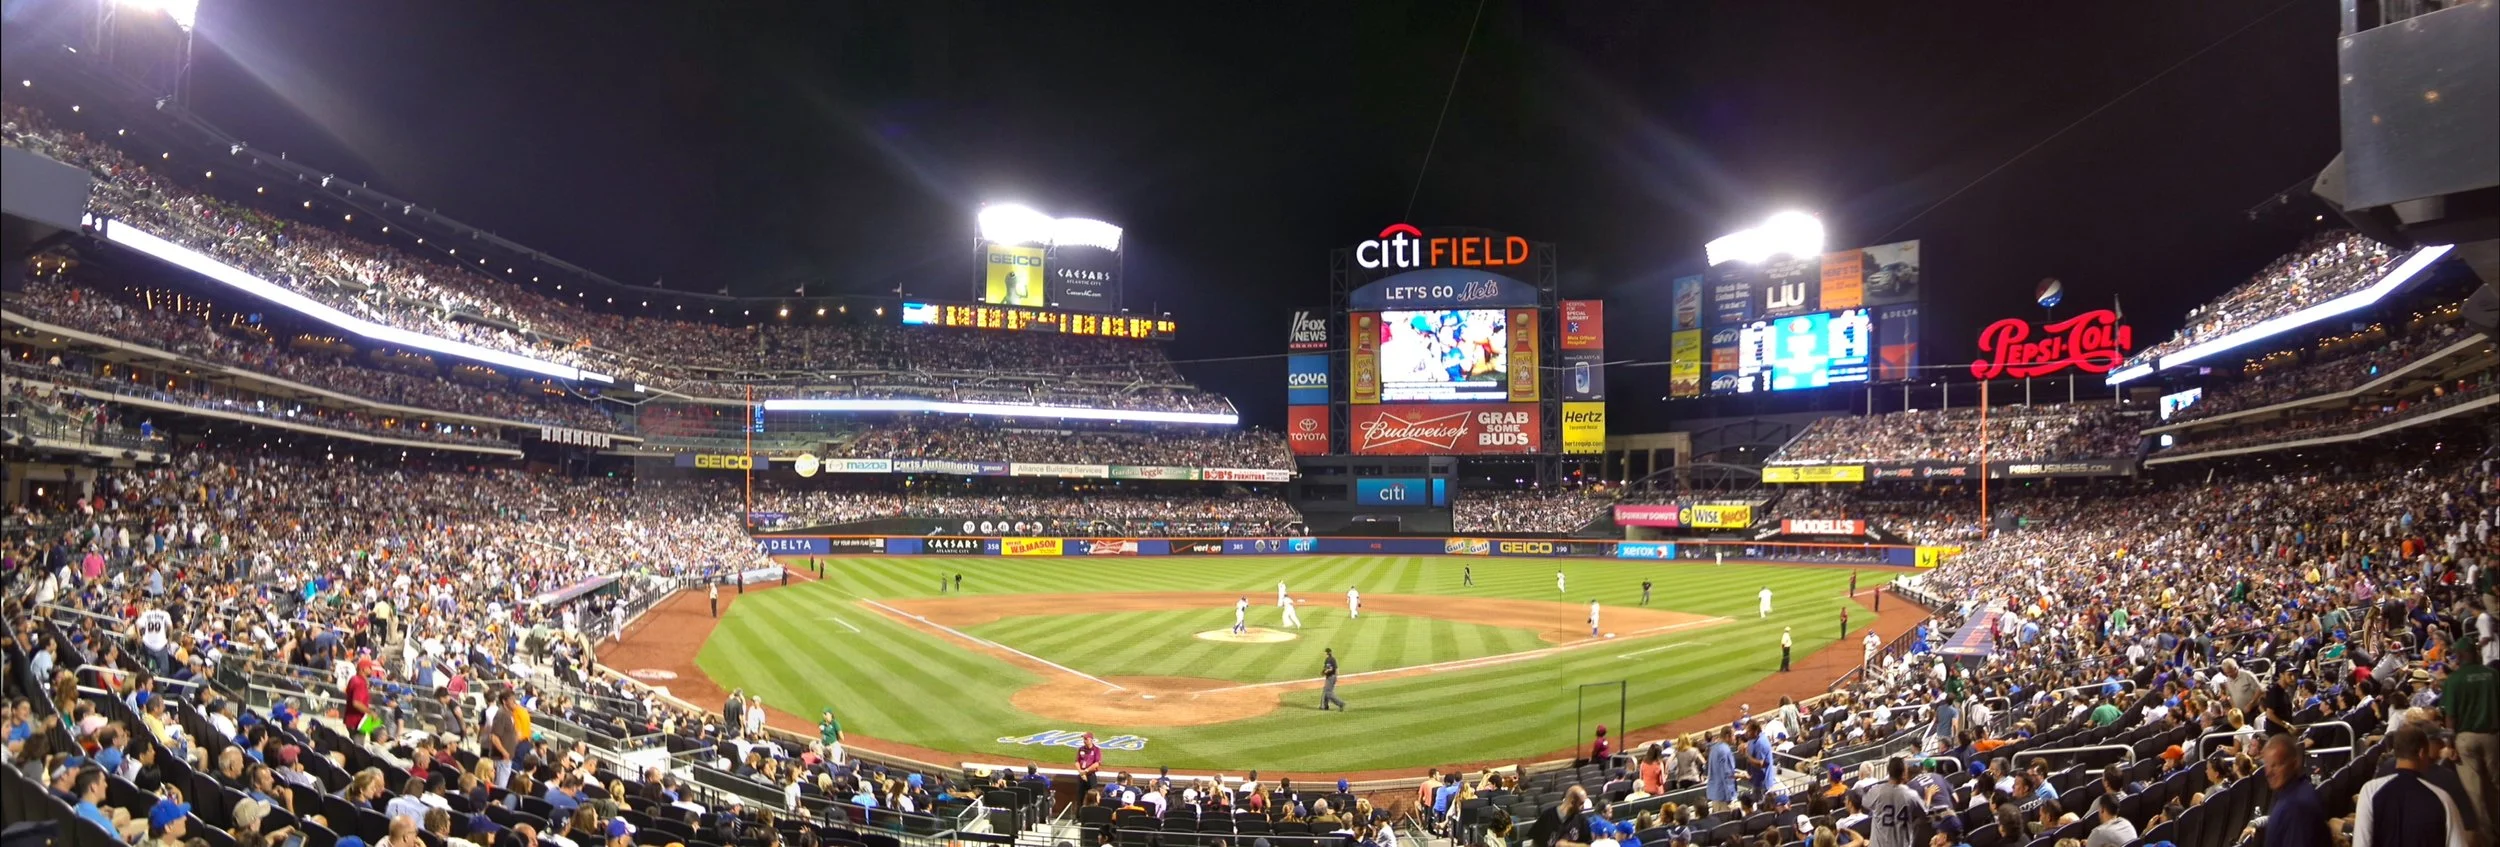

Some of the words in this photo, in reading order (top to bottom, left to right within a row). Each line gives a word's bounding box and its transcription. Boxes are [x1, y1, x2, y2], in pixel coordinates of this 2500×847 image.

[1356, 232, 1420, 269] citi
[1430, 236, 1529, 266] FIELD
[989, 253, 1041, 267] GEICO
[1057, 268, 1110, 281] CAESARS
[1386, 286, 1428, 300] LET'S
[1432, 285, 1453, 298] GO
[1457, 279, 1499, 302] Mets
[1766, 281, 1806, 309] LIU
[1302, 319, 1326, 330] FOX
[1295, 331, 1327, 341] NEWS
[1288, 373, 1327, 386] GOYA
[1477, 412, 1529, 425] GRAB
[1565, 411, 1602, 423] Hertz
[1360, 421, 1468, 440] Budweiser
[1486, 424, 1521, 433] SOME
[1291, 433, 1327, 441] TOYOTA
[1478, 432, 1529, 446] BUDS
[694, 454, 753, 469] GEICO
[1380, 486, 1405, 500] citi
[1790, 519, 1855, 534] MODELL'S
[771, 539, 812, 550] DELTA
[927, 539, 978, 548] CAESARS
[1294, 540, 1310, 551] citi
[1446, 541, 1465, 552] Gulf
[1470, 542, 1488, 553] Gulf
[1500, 542, 1553, 554] GEICO
[1622, 546, 1655, 556] xerox
[1882, 804, 1910, 828] 24
